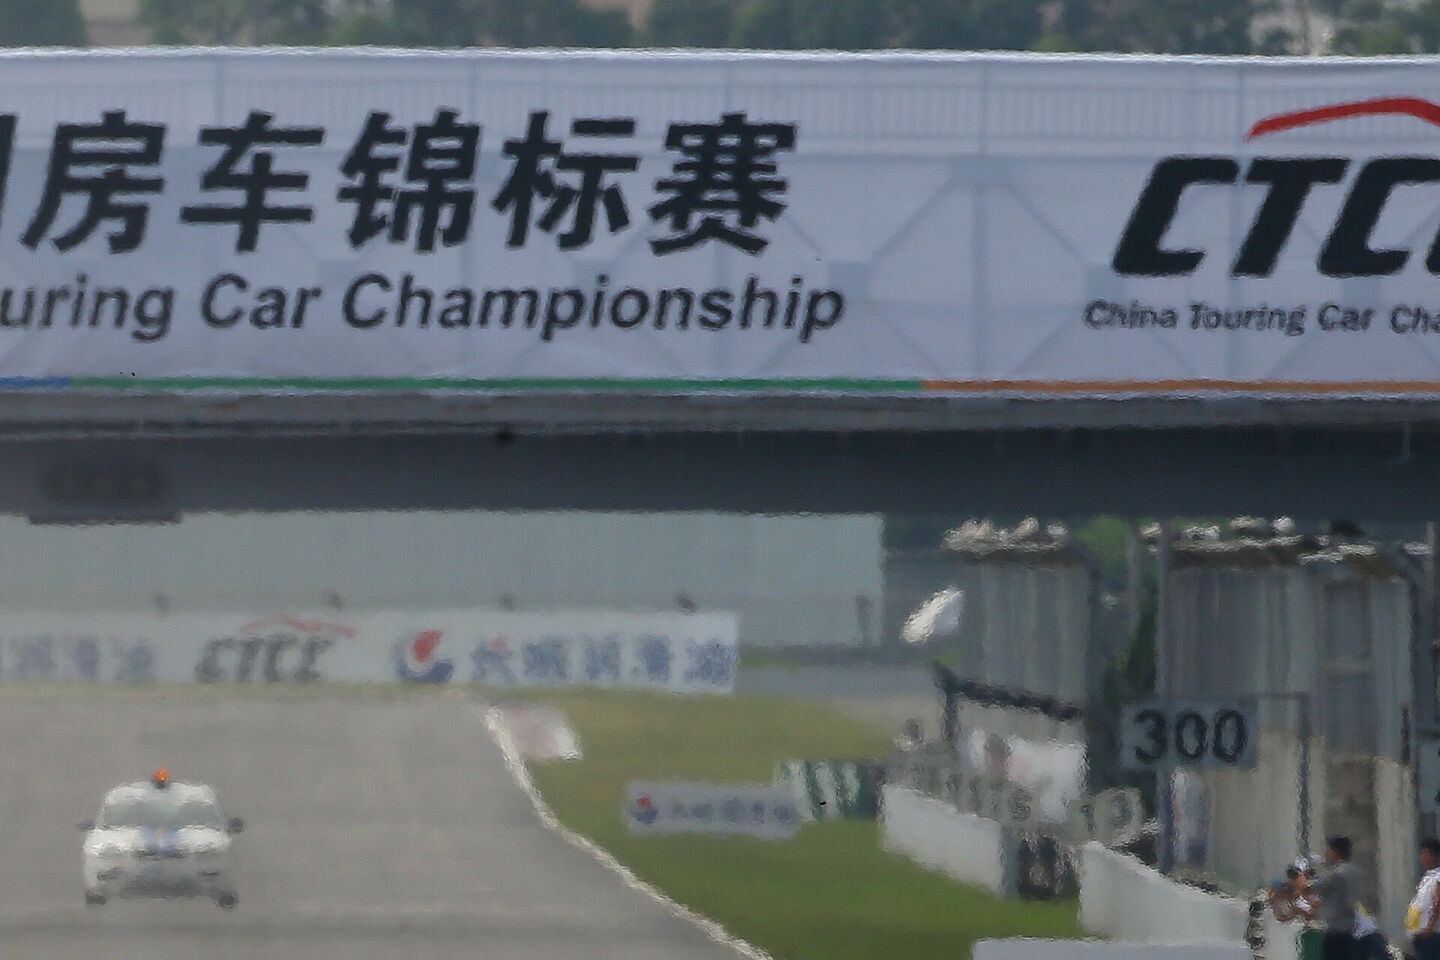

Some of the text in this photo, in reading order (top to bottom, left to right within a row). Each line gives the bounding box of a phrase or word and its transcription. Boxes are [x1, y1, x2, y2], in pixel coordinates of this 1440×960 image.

[1112, 156, 1440, 278] CTC
[200, 273, 321, 330] Car
[341, 271, 846, 344] Championship
[1084, 299, 1178, 330] China
[1189, 302, 1305, 337] Touring
[1318, 302, 1375, 333] Car
[1134, 709, 1248, 763] 300
